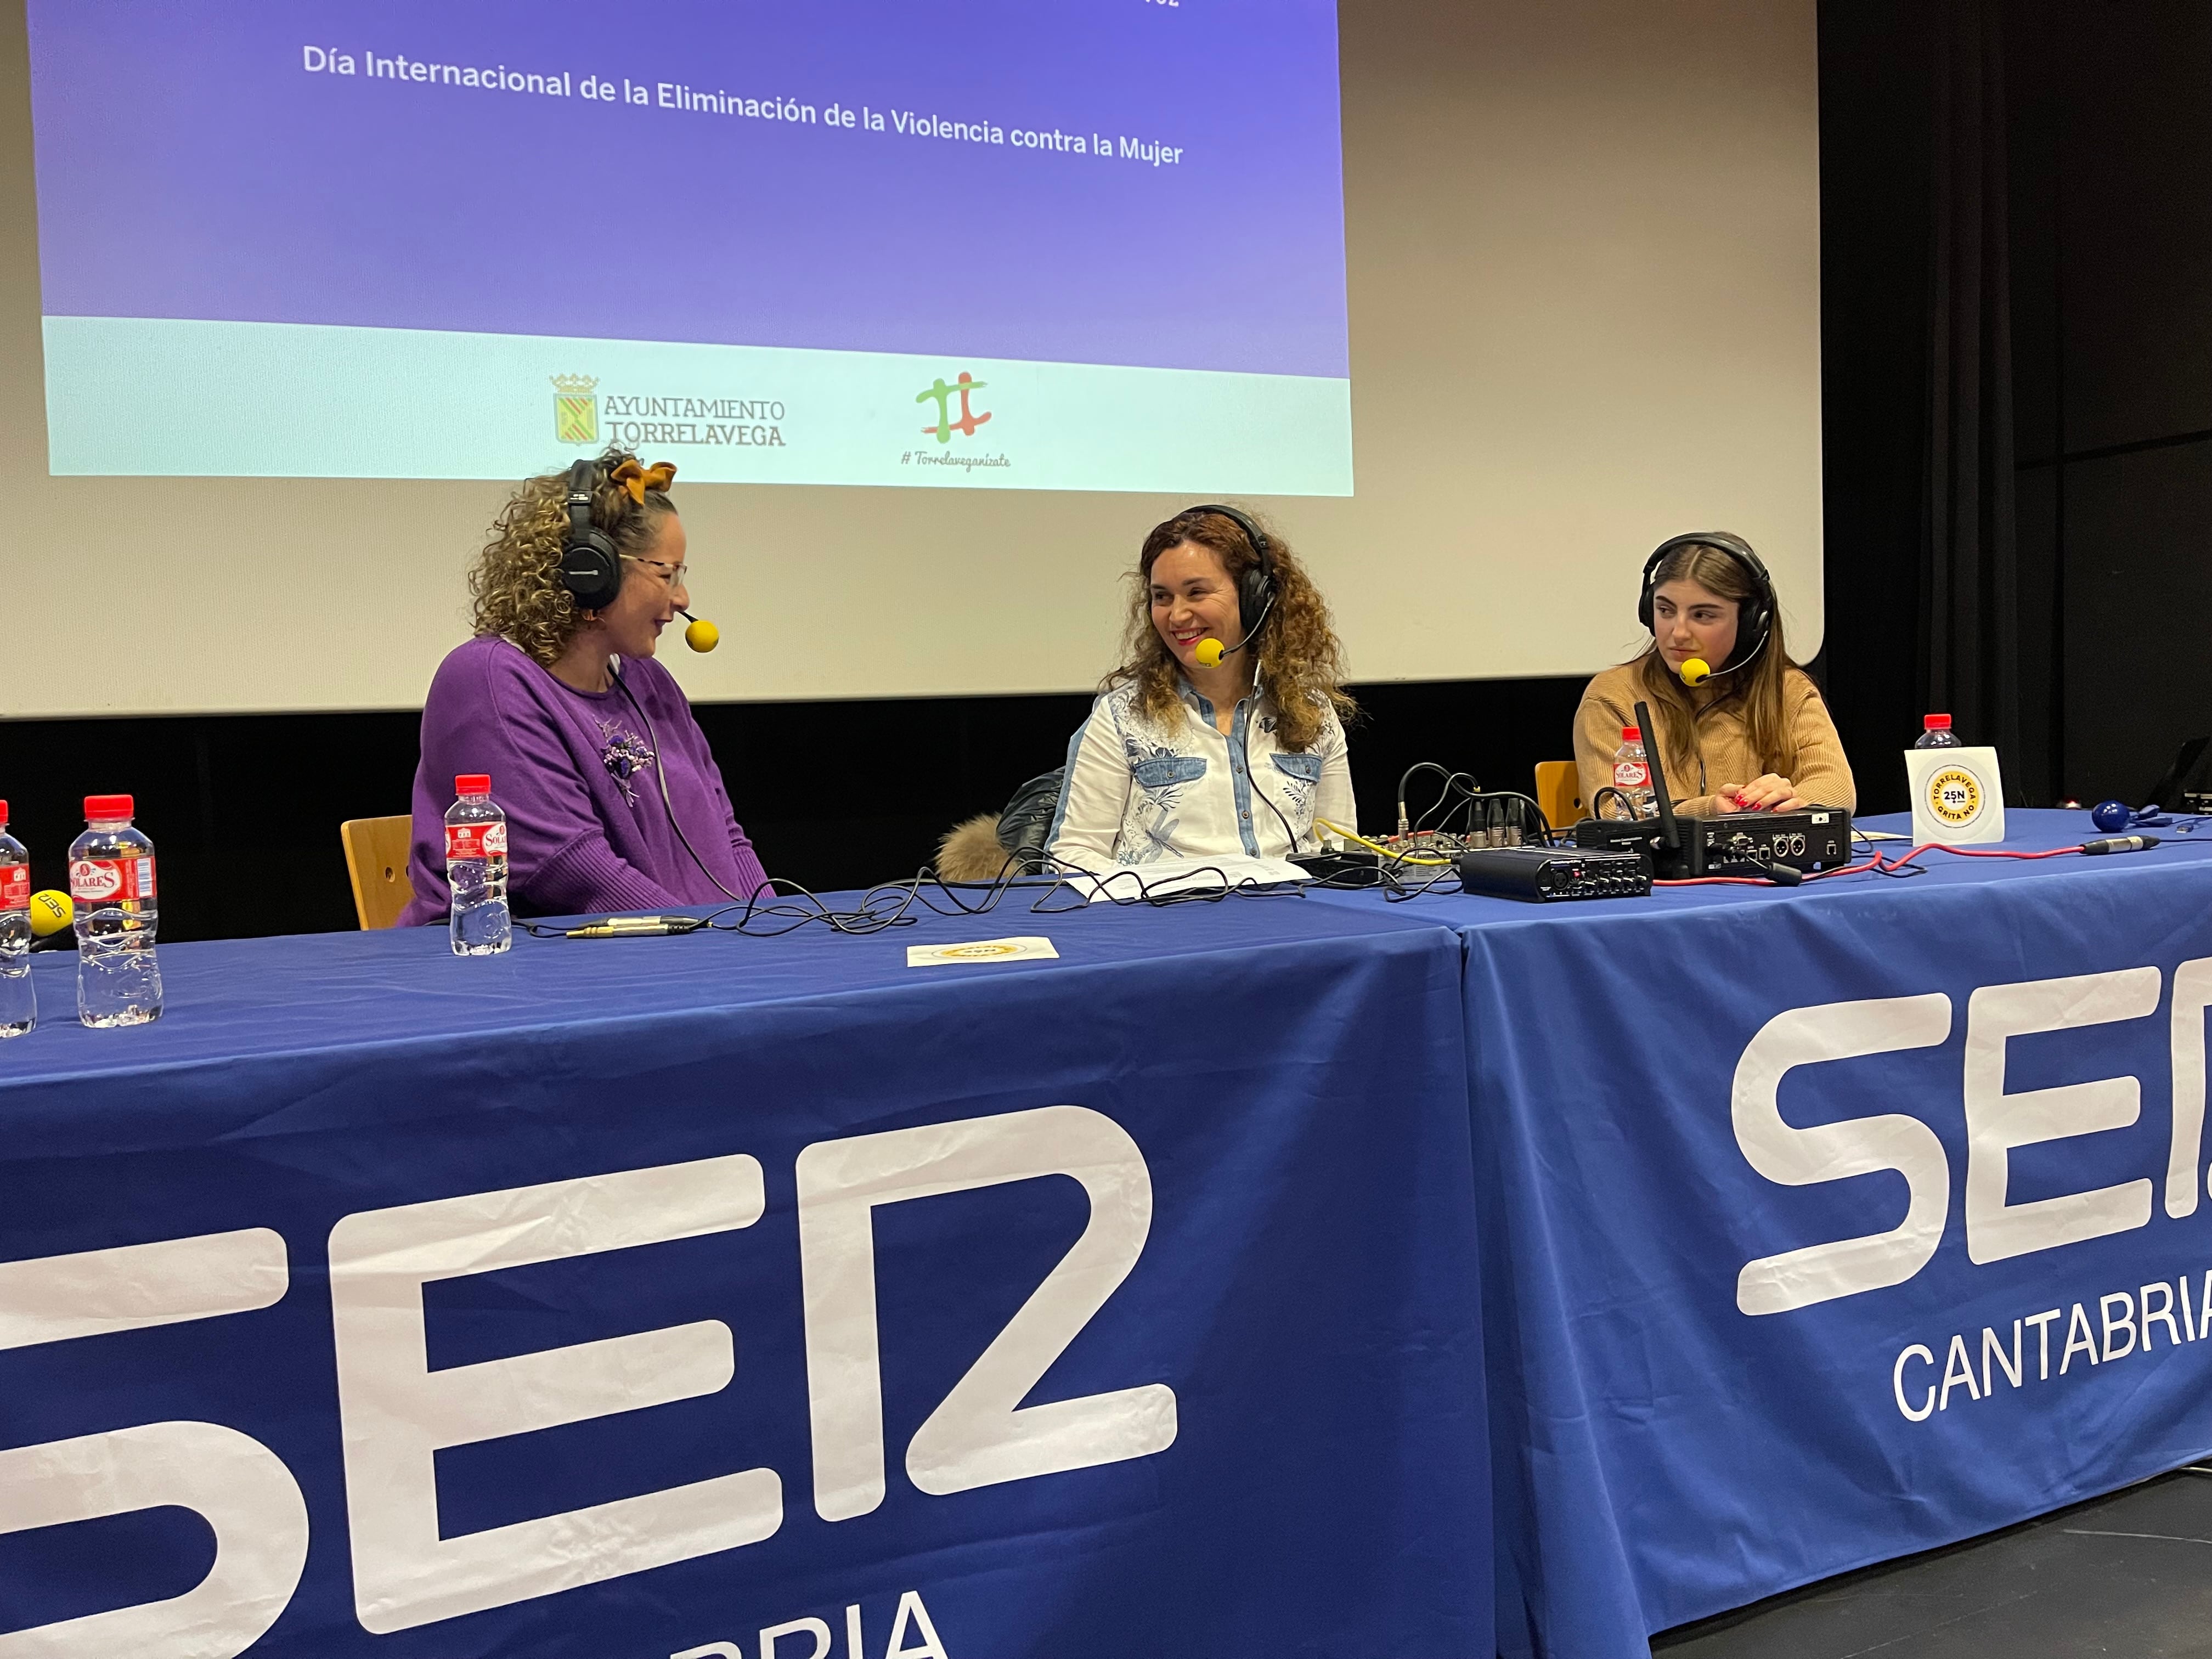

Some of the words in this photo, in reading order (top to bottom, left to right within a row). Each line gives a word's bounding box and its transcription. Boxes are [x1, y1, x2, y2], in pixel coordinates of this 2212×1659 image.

[303, 46, 355, 75] Día
[366, 51, 571, 97] Internacional
[580, 75, 616, 101] de
[624, 79, 648, 105] la
[658, 82, 816, 123] Eliminación
[824, 103, 856, 128] de
[864, 107, 885, 132] la
[891, 109, 1003, 144] Violencia
[1011, 128, 1086, 154] contra
[1093, 133, 1112, 156] la
[1119, 136, 1183, 167] Mujer
[605, 396, 785, 420] AYUNTAMIENTO
[605, 421, 786, 447] TORRELAVEGA
[1933, 774, 1976, 800] TORRELAVEGA
[1944, 791, 1965, 800] 25N
[1938, 806, 1962, 820] GRITA
[1963, 805, 1974, 817] NO
[38, 893, 66, 918] SER
